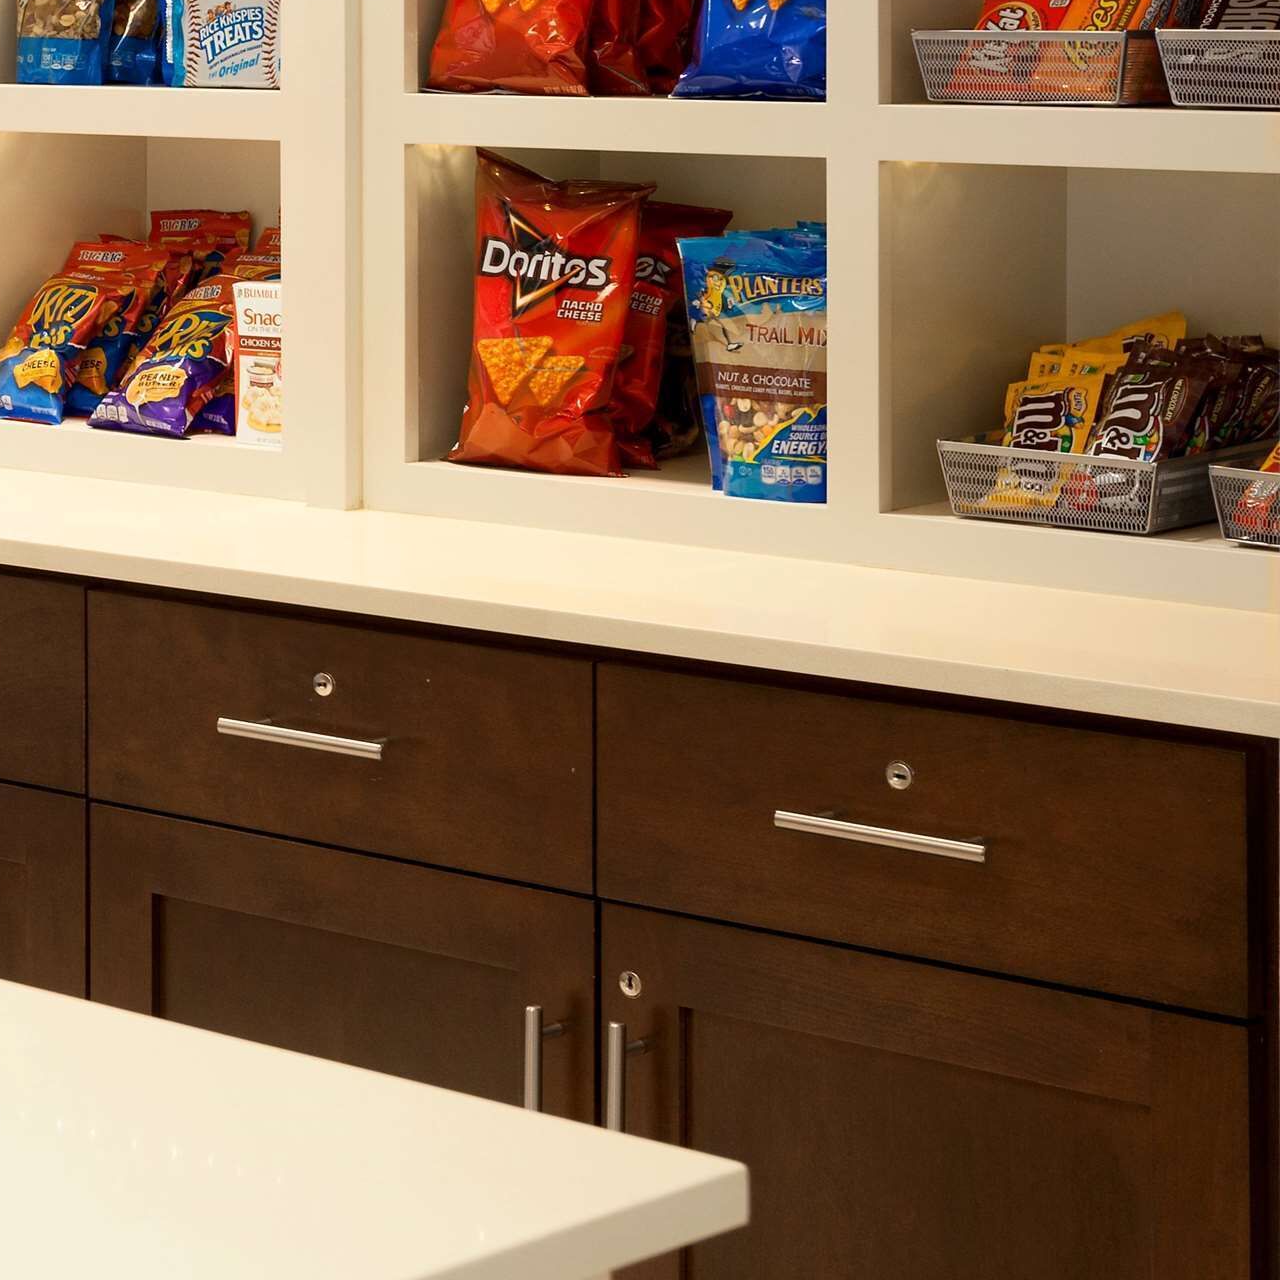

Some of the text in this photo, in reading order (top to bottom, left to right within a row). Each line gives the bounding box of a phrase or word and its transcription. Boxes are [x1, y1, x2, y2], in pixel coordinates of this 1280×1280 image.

[200, 8, 263, 40] RICE KRISPIES
[201, 21, 264, 63] TREATS
[219, 53, 260, 78] Original
[160, 218, 200, 232] BIG BAG
[482, 239, 608, 286] Doritos
[243, 288, 279, 299] BUMBLE
[728, 273, 823, 304] PLANTERS
[631, 291, 663, 305] ACHO
[561, 299, 603, 312] NACHO
[243, 308, 281, 327] Snac
[556, 309, 603, 322] CHEESE
[745, 323, 794, 345] TRAIL
[240, 338, 270, 347] CHICKEN
[22, 360, 56, 372] CHEESE
[140, 372, 181, 381] PEANUT
[718, 371, 811, 389] NUT & CHOCOLATE
[789, 432, 818, 440] SOURCE
